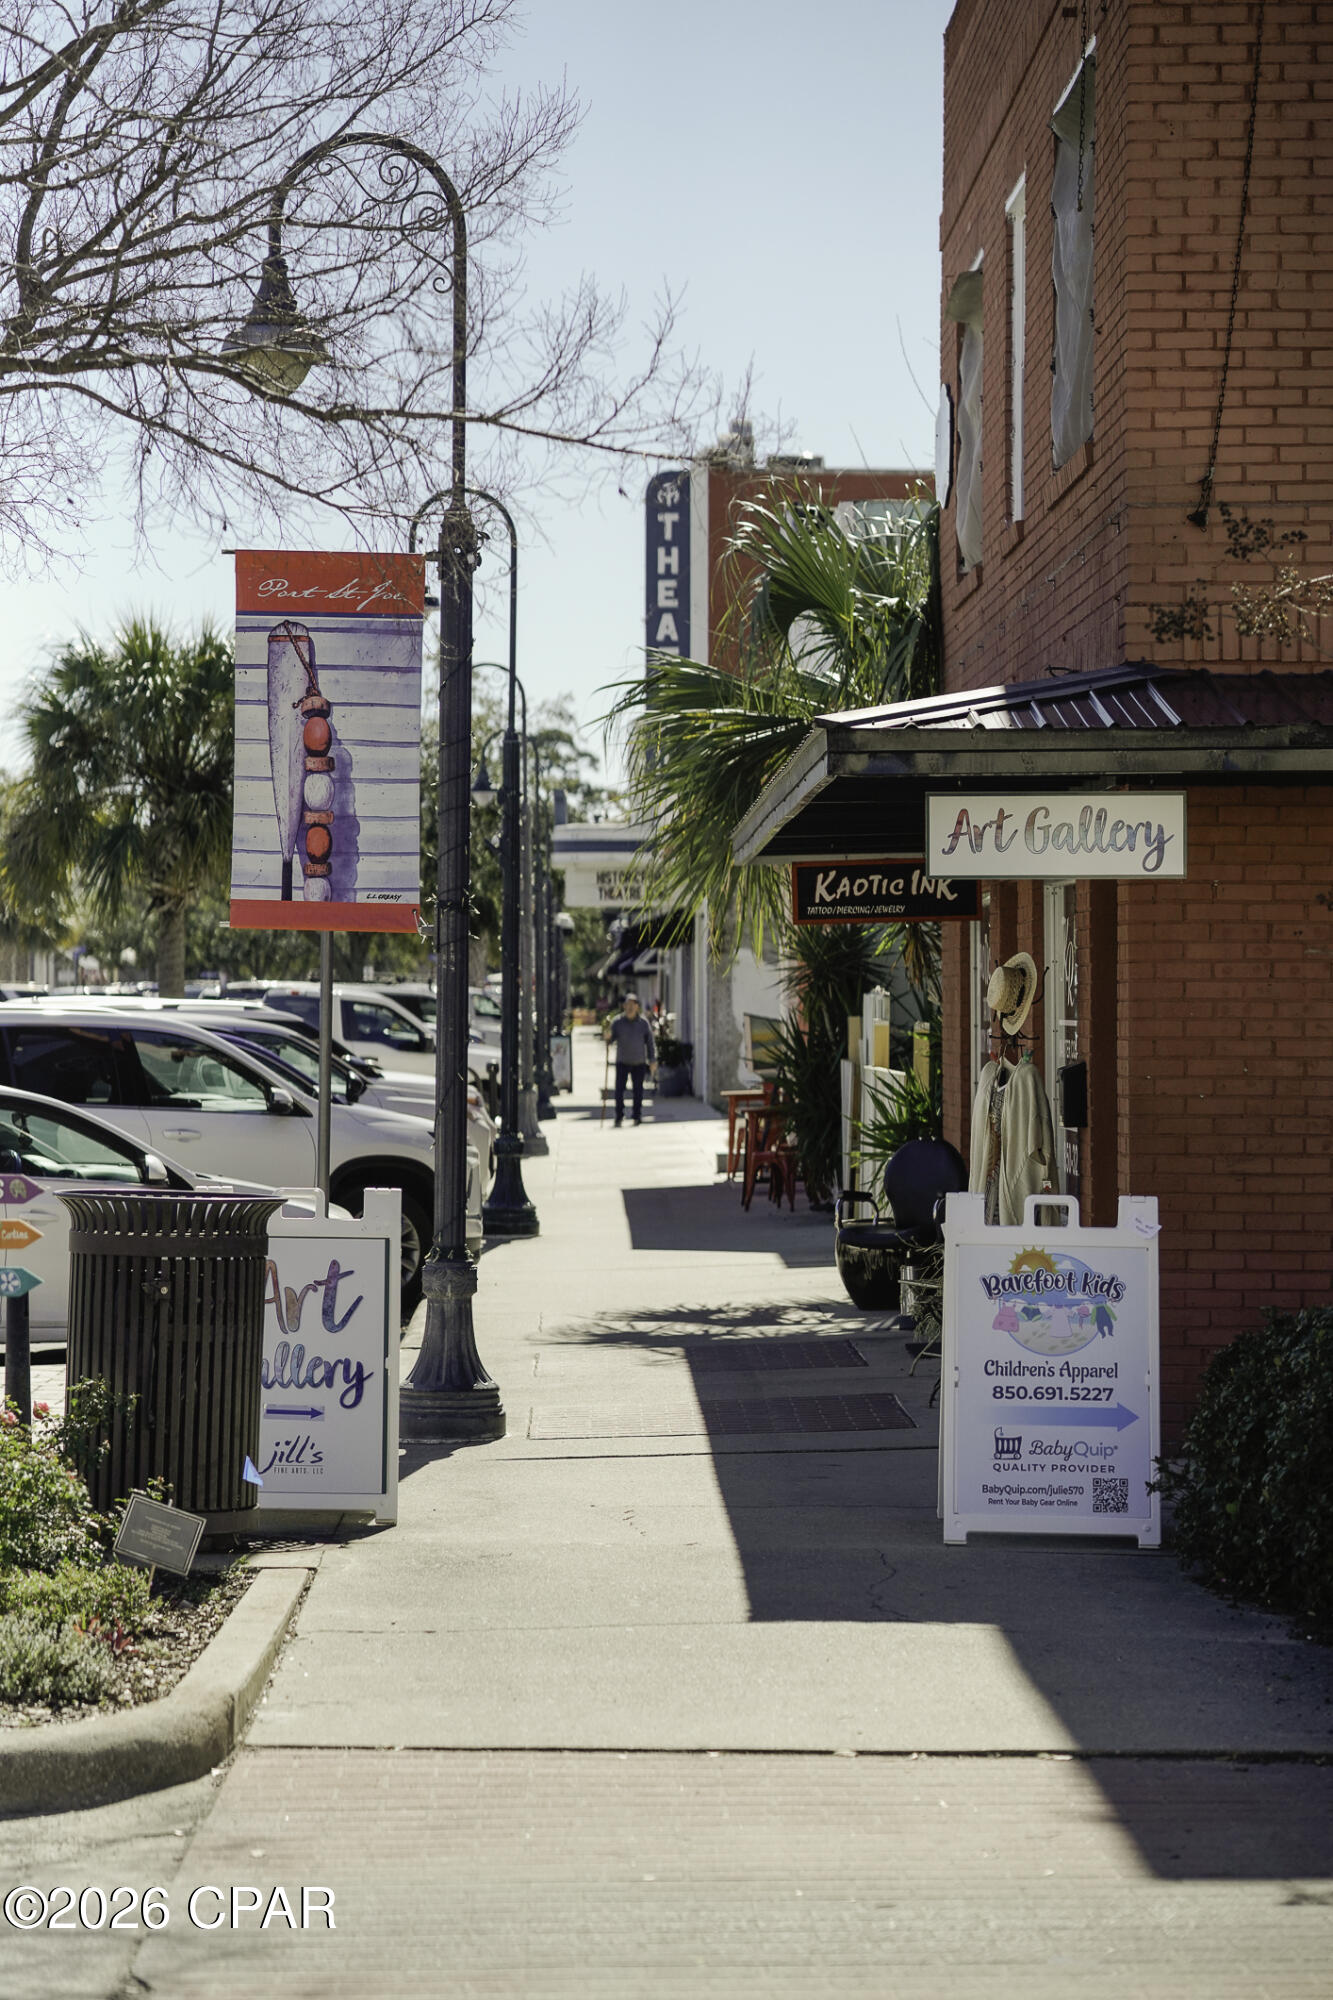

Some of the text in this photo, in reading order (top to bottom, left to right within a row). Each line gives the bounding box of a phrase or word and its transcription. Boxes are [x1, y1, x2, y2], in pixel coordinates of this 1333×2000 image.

[257, 578, 327, 597] Port
[326, 578, 368, 599] St.
[942, 805, 1174, 872] Art Gallery
[814, 869, 958, 903] KAOTIC INK
[807, 904, 905, 915] TATTOO/PIERCING/JEWELRY
[980, 1268, 1125, 1300] Barefoot Kids
[264, 1259, 363, 1335] Art
[984, 1360, 1118, 1384] Children's Apparel
[992, 1385, 1114, 1401] 850.691.5227
[258, 1435, 324, 1475] jill's
[993, 1463, 1116, 1473] QUALITY PROVIDER
[982, 1484, 1085, 1496] BabyQuip.com/julie570
[1005, 1498, 1020, 1506] Your
[1021, 1499, 1039, 1507] Baby
[1056, 1499, 1078, 1507] Online
